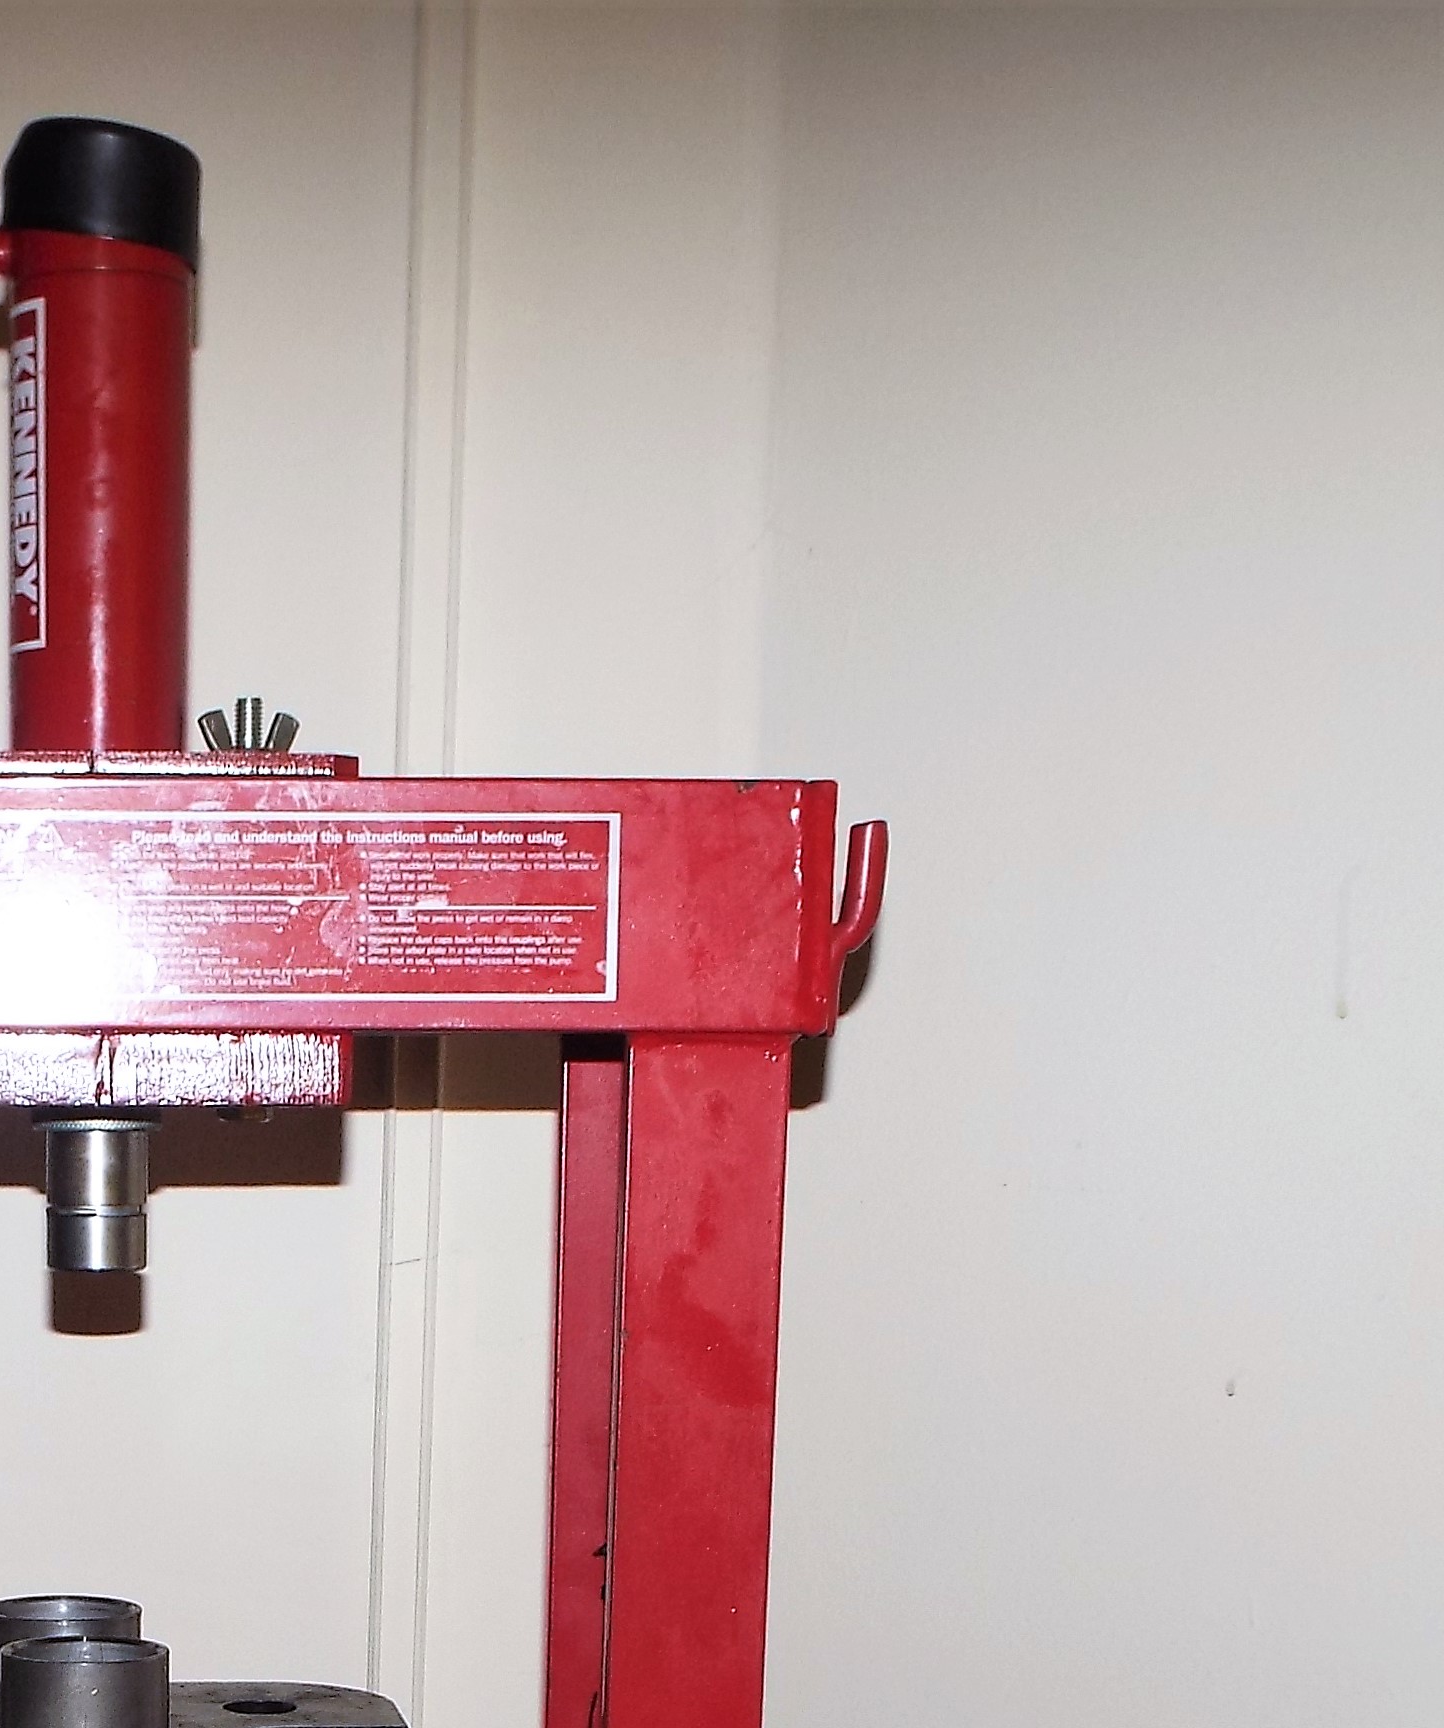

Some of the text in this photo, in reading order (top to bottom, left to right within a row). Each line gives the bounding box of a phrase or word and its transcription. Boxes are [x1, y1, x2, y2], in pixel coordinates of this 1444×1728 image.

[10, 336, 39, 605] KENNEDY
[214, 829, 239, 844] and
[243, 829, 318, 844] understand
[321, 830, 343, 844] the
[346, 830, 426, 845] instructions
[429, 830, 478, 845] manual
[481, 830, 524, 844] before
[526, 831, 567, 847] using.
